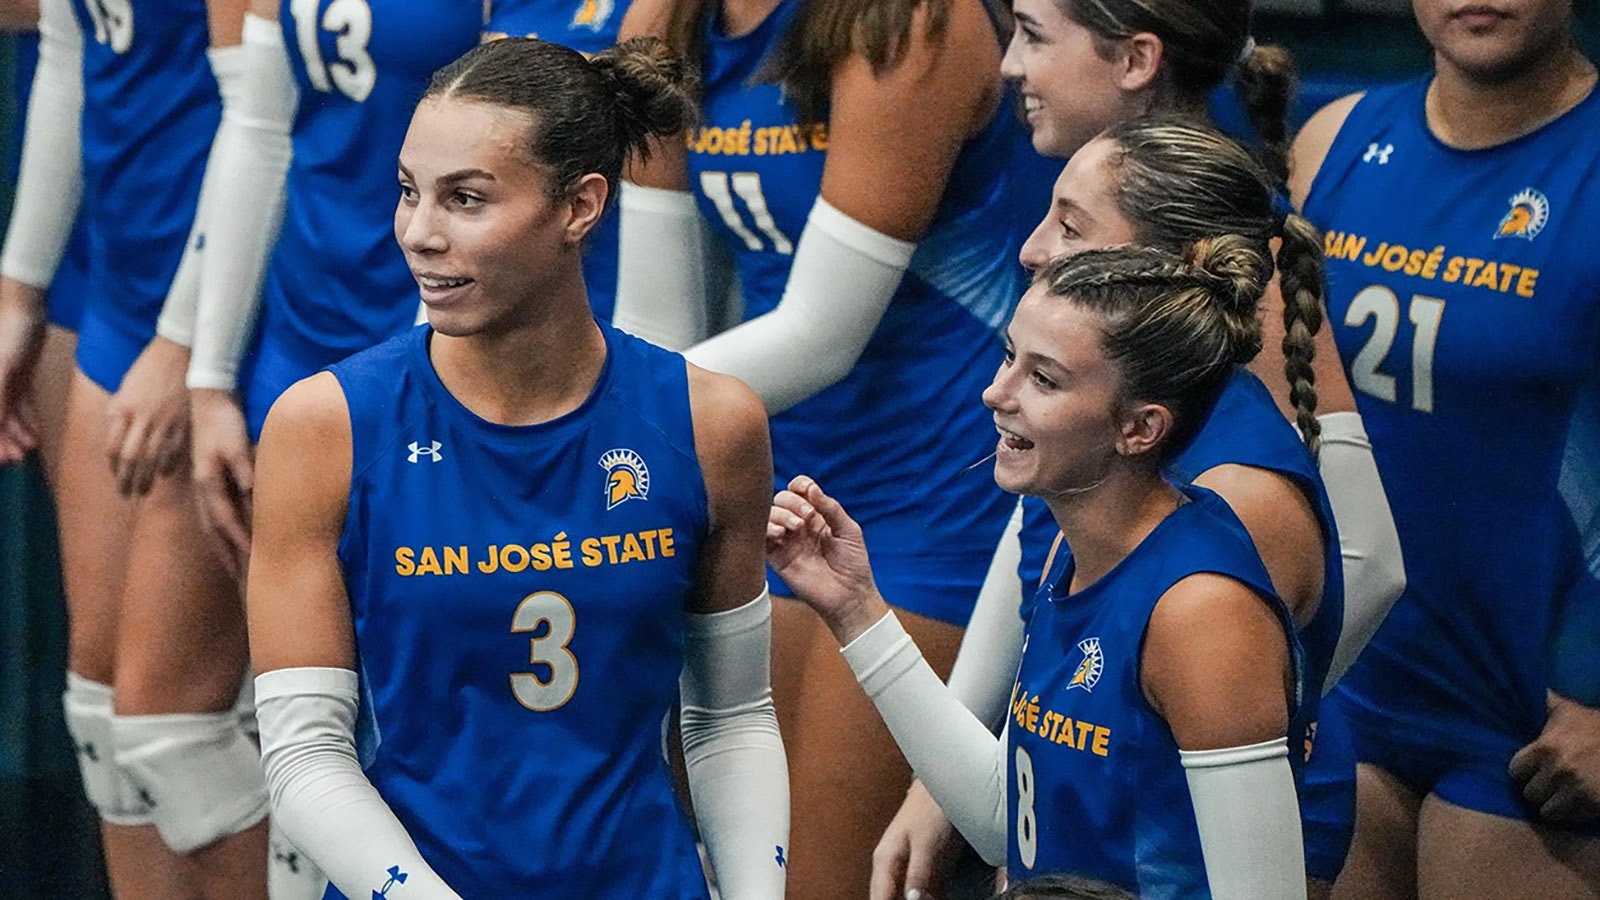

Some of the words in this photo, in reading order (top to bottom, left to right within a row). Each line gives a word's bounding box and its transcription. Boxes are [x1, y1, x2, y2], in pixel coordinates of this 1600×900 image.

[290, 0, 376, 103] 13
[700, 170, 794, 255] 11
[1325, 231, 1366, 261] SAN
[1363, 246, 1445, 279] JOSÉ
[1443, 257, 1539, 298] STATE
[1345, 285, 1445, 414] 21
[395, 546, 469, 577] SAN
[477, 531, 574, 574] JOSÉ
[581, 527, 675, 567] STATE
[509, 590, 579, 712] 3
[1039, 710, 1111, 757] STATE
[1016, 746, 1037, 870] 8
